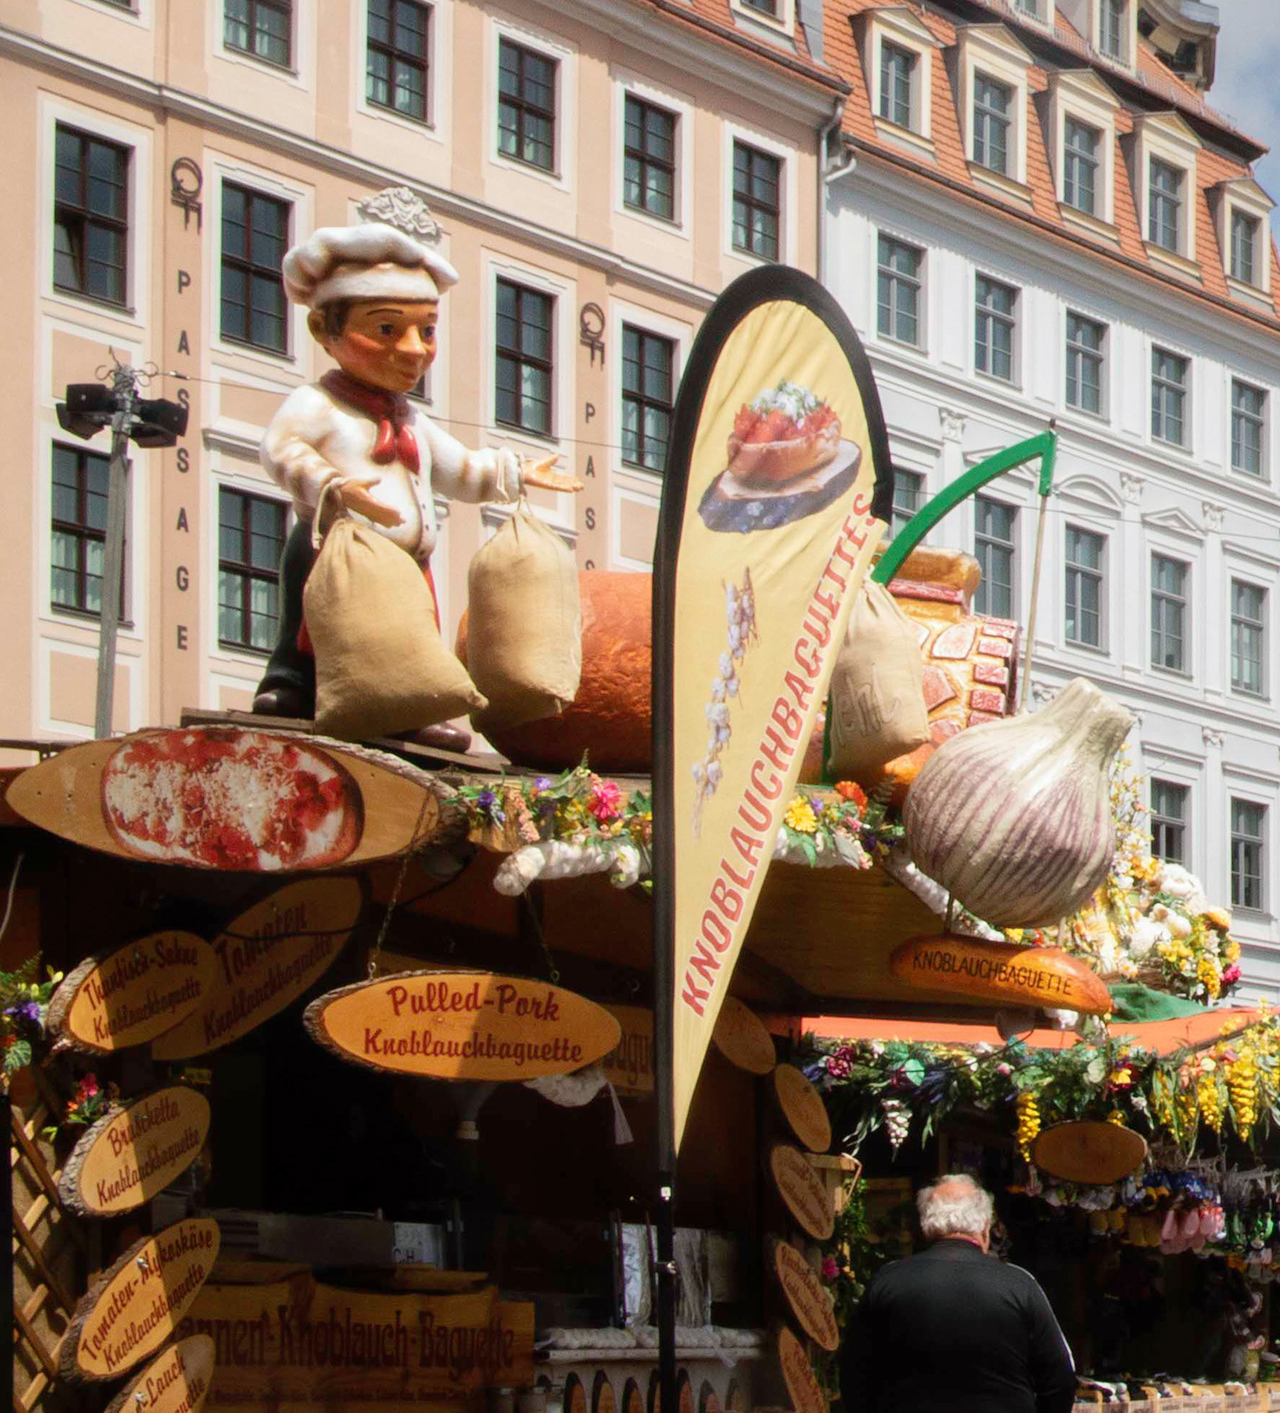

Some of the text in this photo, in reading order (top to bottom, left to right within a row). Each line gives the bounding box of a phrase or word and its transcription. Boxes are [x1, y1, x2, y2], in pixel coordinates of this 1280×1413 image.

[176, 271, 191, 651] PASSAGE
[681, 493, 877, 1018] KNOBLAUCHBAGUETTES
[387, 982, 560, 1021] Pulled-Pork
[913, 950, 1073, 996] KNOBLAUCHBAGUETTE
[364, 1028, 583, 1066] Knoblauchbaguette
[107, 1096, 180, 1159] Bruschetta
[97, 1130, 200, 1206] Knoblauchbaguette
[103, 1264, 206, 1372] Knoblauchbaguette
